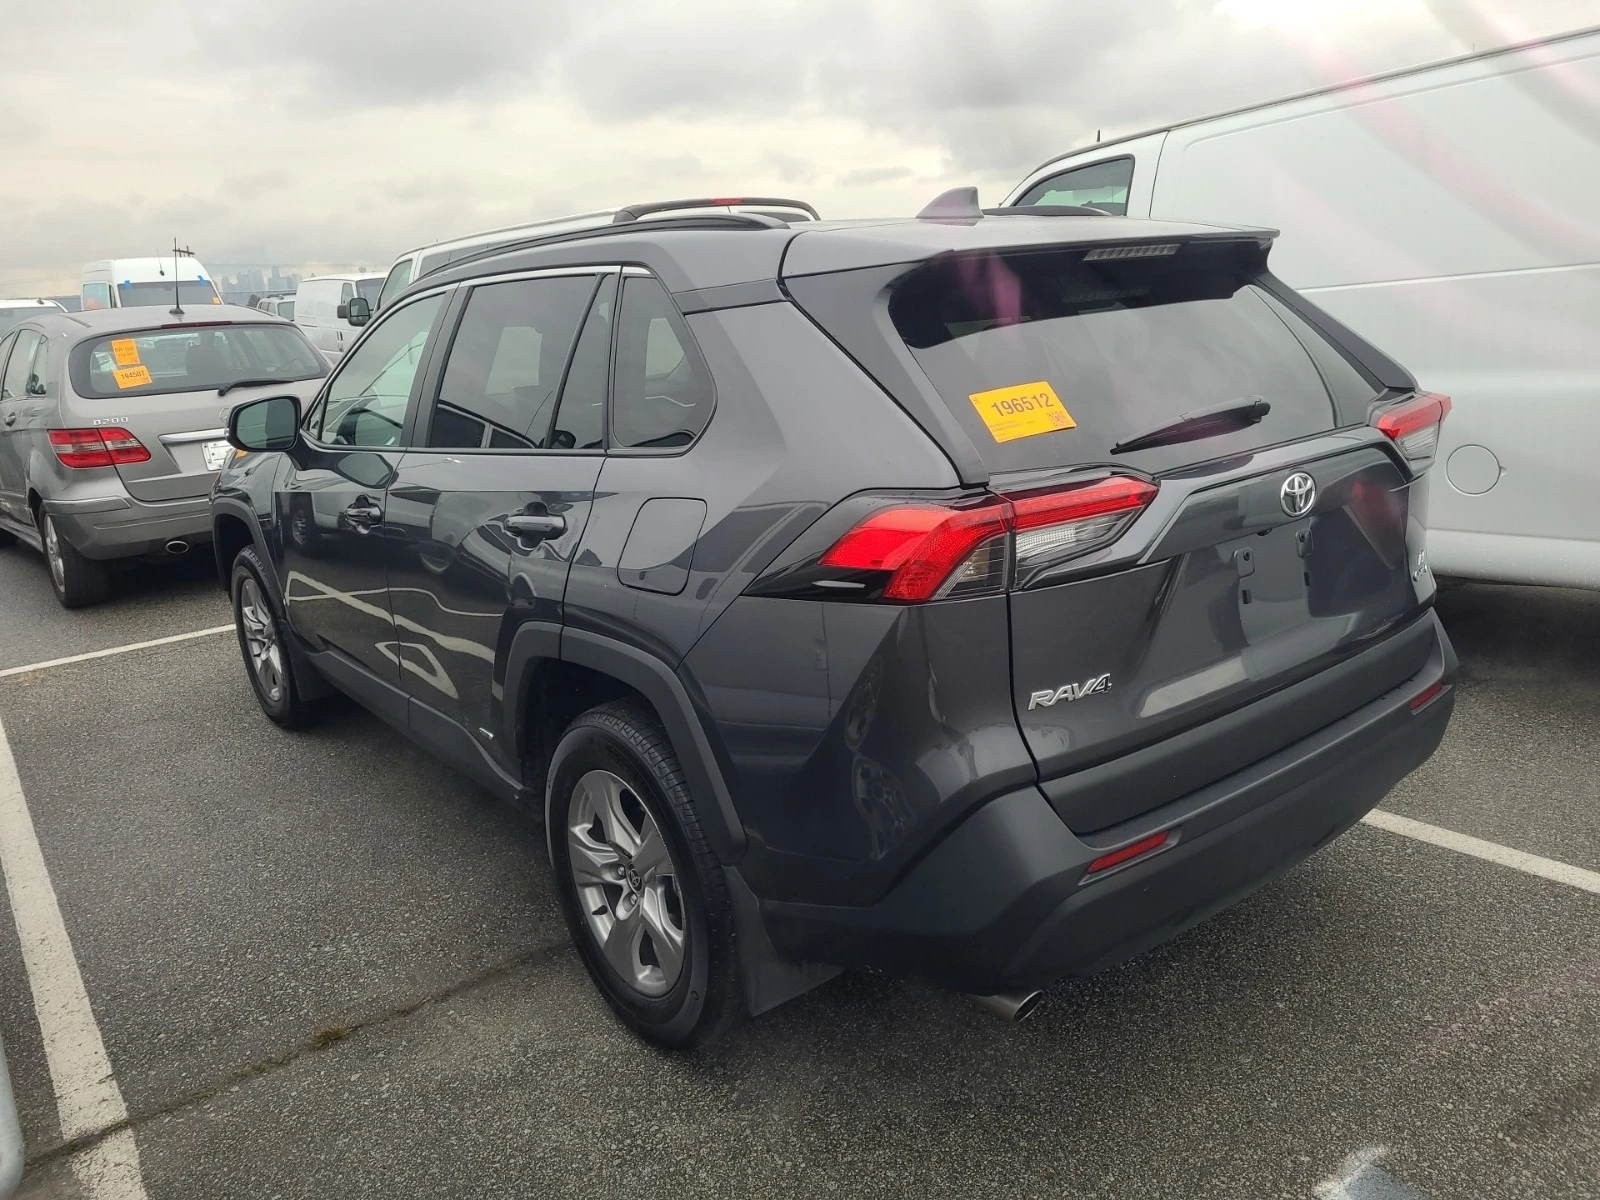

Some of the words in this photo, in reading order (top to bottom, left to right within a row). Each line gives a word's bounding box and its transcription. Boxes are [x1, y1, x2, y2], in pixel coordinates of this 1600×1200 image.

[991, 392, 1054, 417] 196512
[93, 416, 129, 426] B200
[1027, 673, 1112, 711] RAV4
